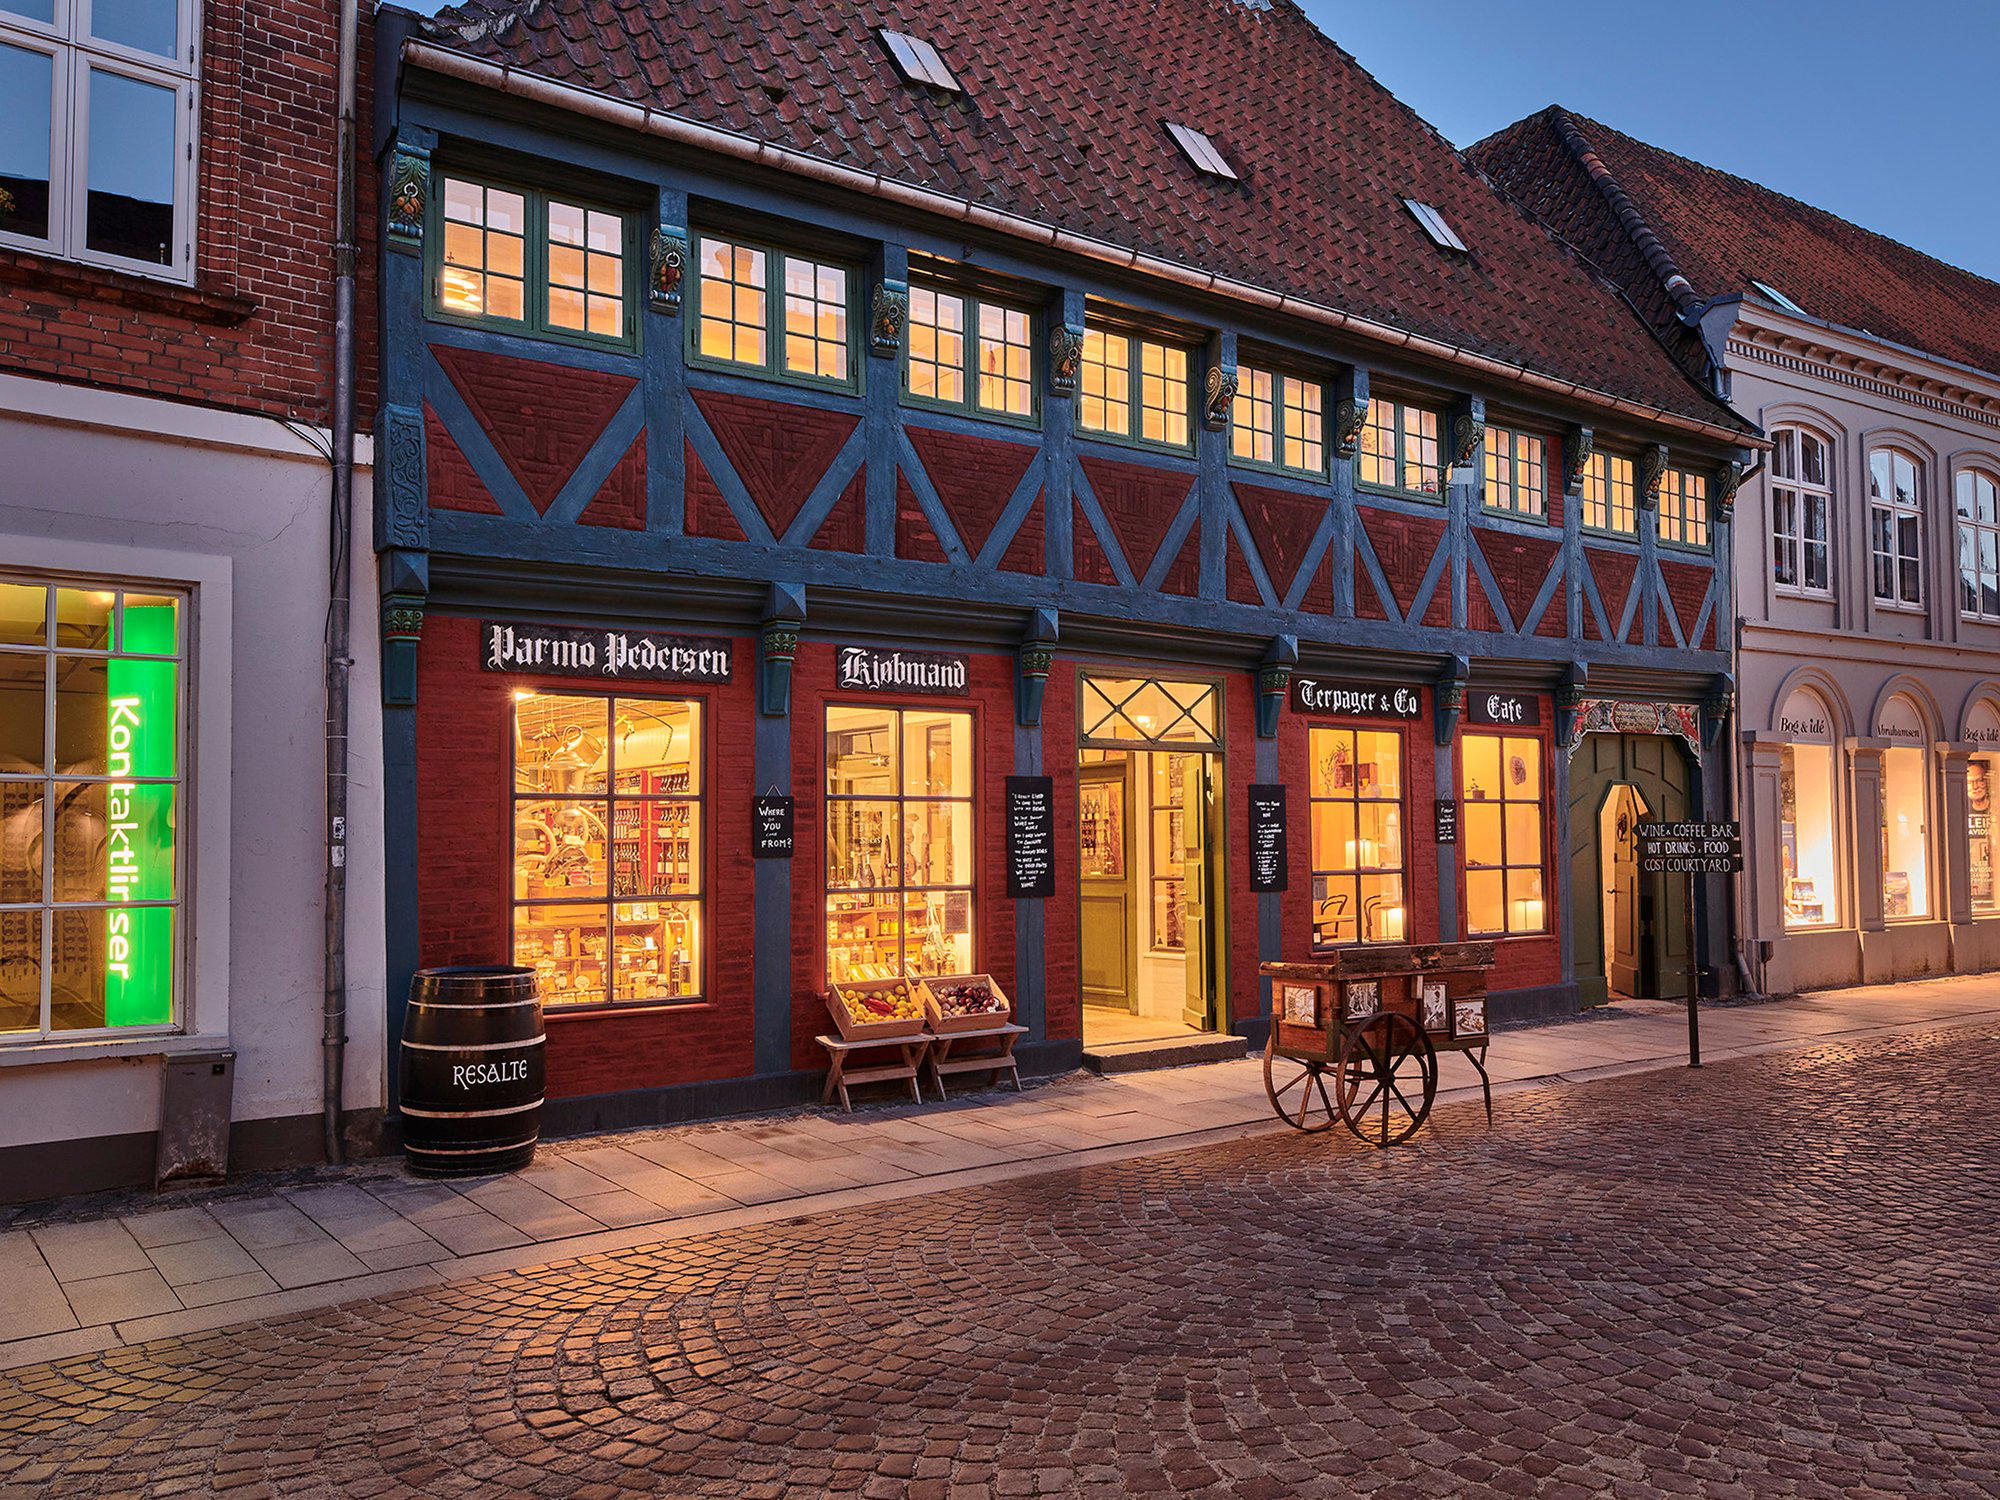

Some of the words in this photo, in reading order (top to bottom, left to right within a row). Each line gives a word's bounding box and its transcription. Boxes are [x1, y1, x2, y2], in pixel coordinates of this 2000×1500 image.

[487, 625, 596, 671] Parmo
[602, 632, 730, 677] Pedersen
[840, 647, 967, 689] Kjøbmand
[1298, 680, 1377, 714] Terpager
[1380, 694, 1391, 711] &
[1394, 687, 1418, 717] Co
[1486, 694, 1523, 722] Cafe
[1781, 717, 1799, 735] Bog
[1801, 721, 1808, 733] &
[1810, 718, 1825, 734] idé
[1964, 727, 1979, 742] Bog
[1986, 727, 1999, 742] idé
[758, 806, 785, 816] WHERE
[763, 822, 781, 831] YOU
[1639, 824, 1665, 837] WINE
[1673, 823, 1707, 837] COFFEE
[1711, 824, 1735, 837] BAR
[761, 837, 792, 848] FROM?
[1647, 841, 1661, 854] HOT
[1665, 841, 1696, 854] DRINKS
[1704, 841, 1729, 854] FOOD
[1644, 858, 1665, 871] COSY
[1666, 858, 1731, 872] COURTYARD
[453, 1059, 528, 1090] RESALTE
